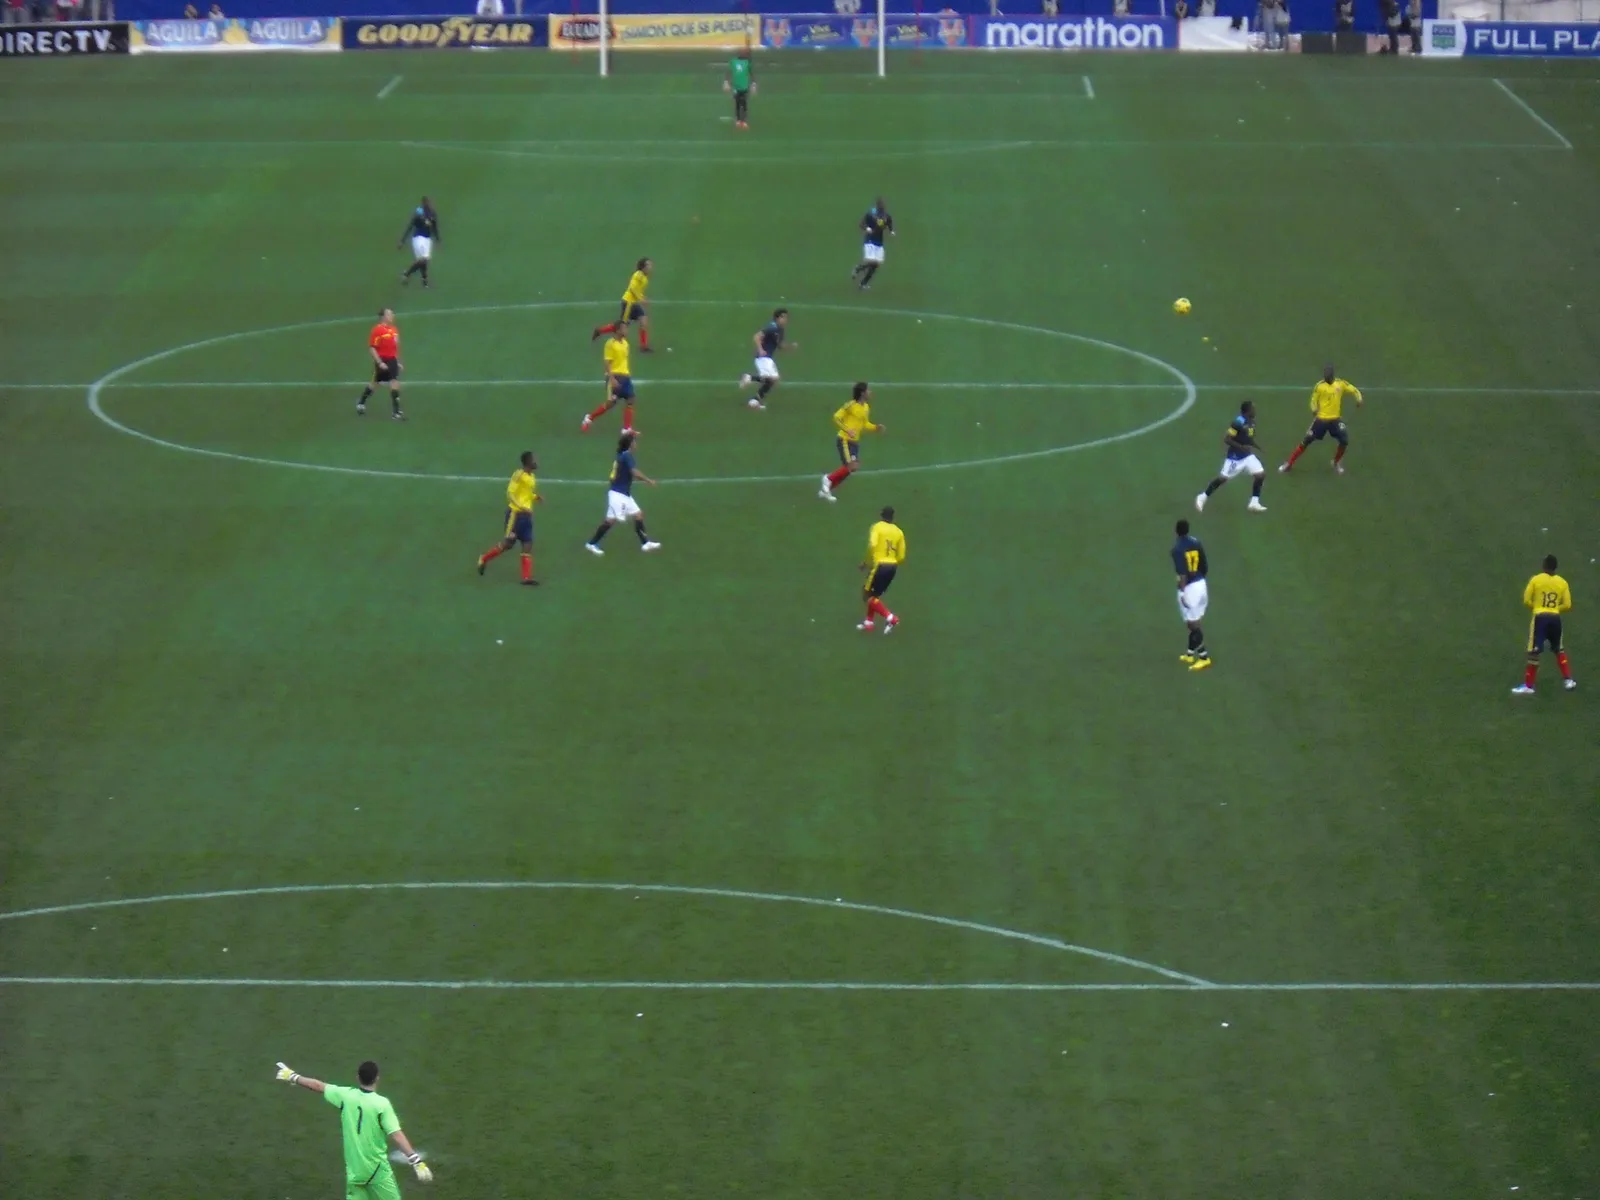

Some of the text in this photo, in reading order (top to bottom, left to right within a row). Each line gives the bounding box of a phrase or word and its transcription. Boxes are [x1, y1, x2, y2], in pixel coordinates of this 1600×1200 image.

[0, 29, 112, 53] IRECTV
[670, 23, 695, 36] QUE
[986, 16, 1164, 47] marathon
[1474, 29, 1547, 49] FULL
[1184, 549, 1200, 573] 17
[1541, 591, 1559, 608] 18
[357, 1105, 363, 1135] 1
